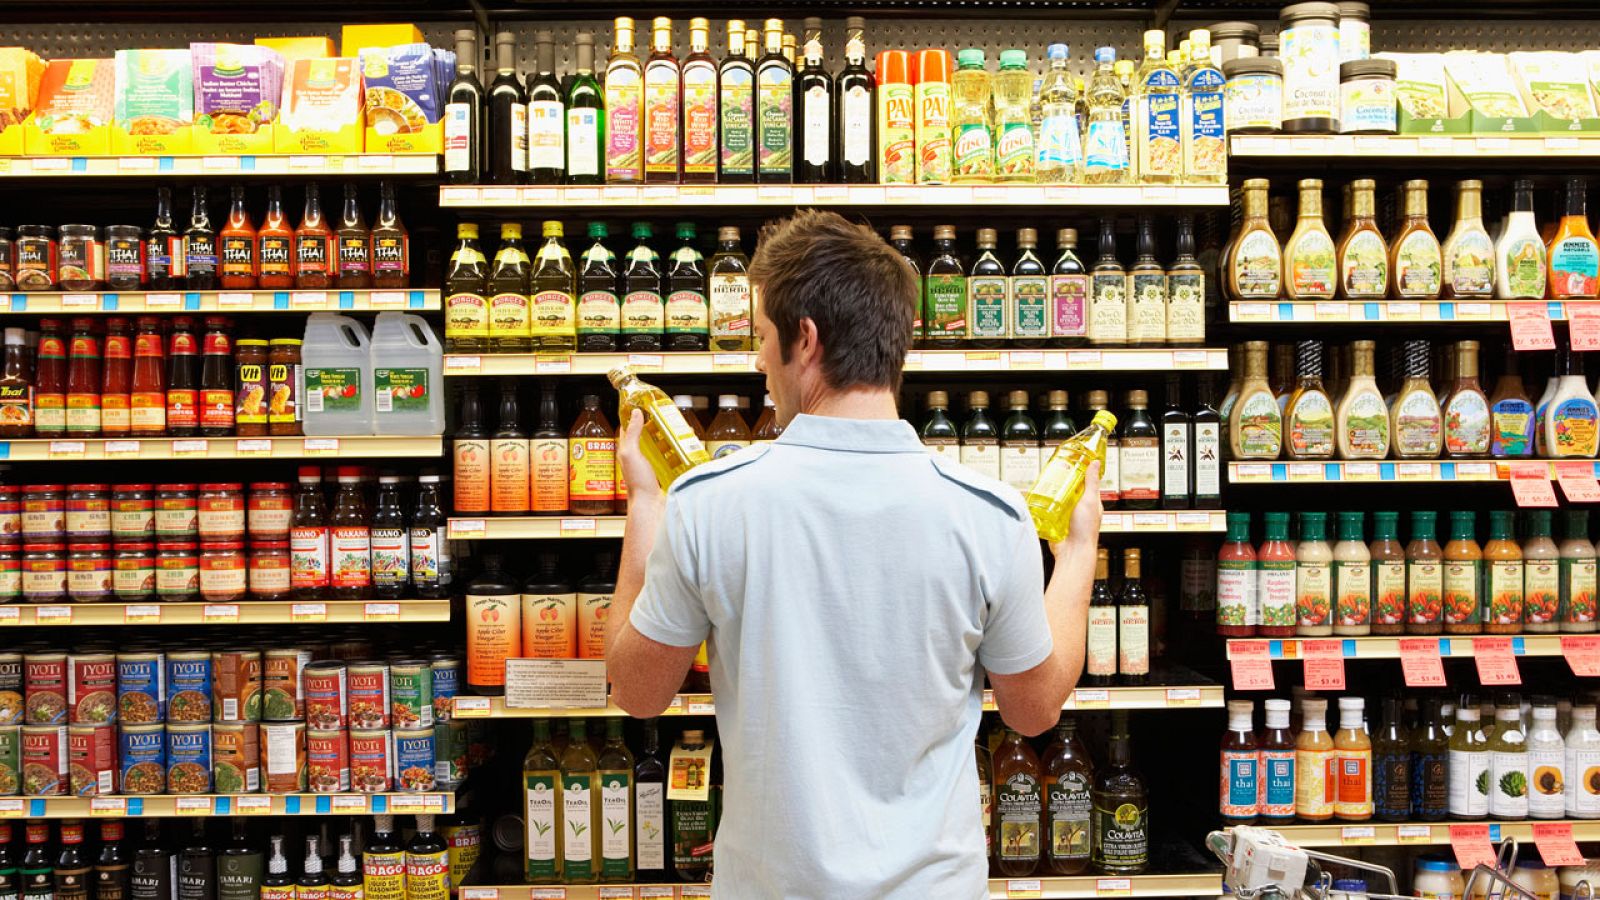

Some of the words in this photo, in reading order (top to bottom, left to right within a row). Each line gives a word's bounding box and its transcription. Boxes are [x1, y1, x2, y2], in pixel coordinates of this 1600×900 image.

[955, 134, 989, 159] Crisco
[999, 132, 1031, 158] Crisco
[190, 243, 213, 254] THAI
[261, 248, 288, 260] THAI
[297, 248, 324, 259] THAI
[341, 248, 368, 258] THAI
[375, 248, 402, 258] THAI
[20, 252, 41, 261] THAI
[110, 249, 137, 262] THAI
[224, 249, 251, 260] THAI
[0, 387, 24, 396] Thai
[536, 627, 548, 635] Apple
[434, 670, 458, 681] YOTI
[1320, 677, 1340, 685] $3.49
[392, 676, 413, 687] YOTI
[24, 735, 50, 747] YOTI
[1235, 779, 1253, 789] thai
[1272, 778, 1291, 788] thai
[1343, 777, 1361, 786] thai
[999, 792, 1040, 802] COLAVITA
[1050, 790, 1091, 801] COLAVITA
[1107, 829, 1145, 840] COLAVITA
[365, 864, 404, 876] BRAGG
[132, 877, 159, 886] AMARI
[179, 876, 206, 886] AMARI
